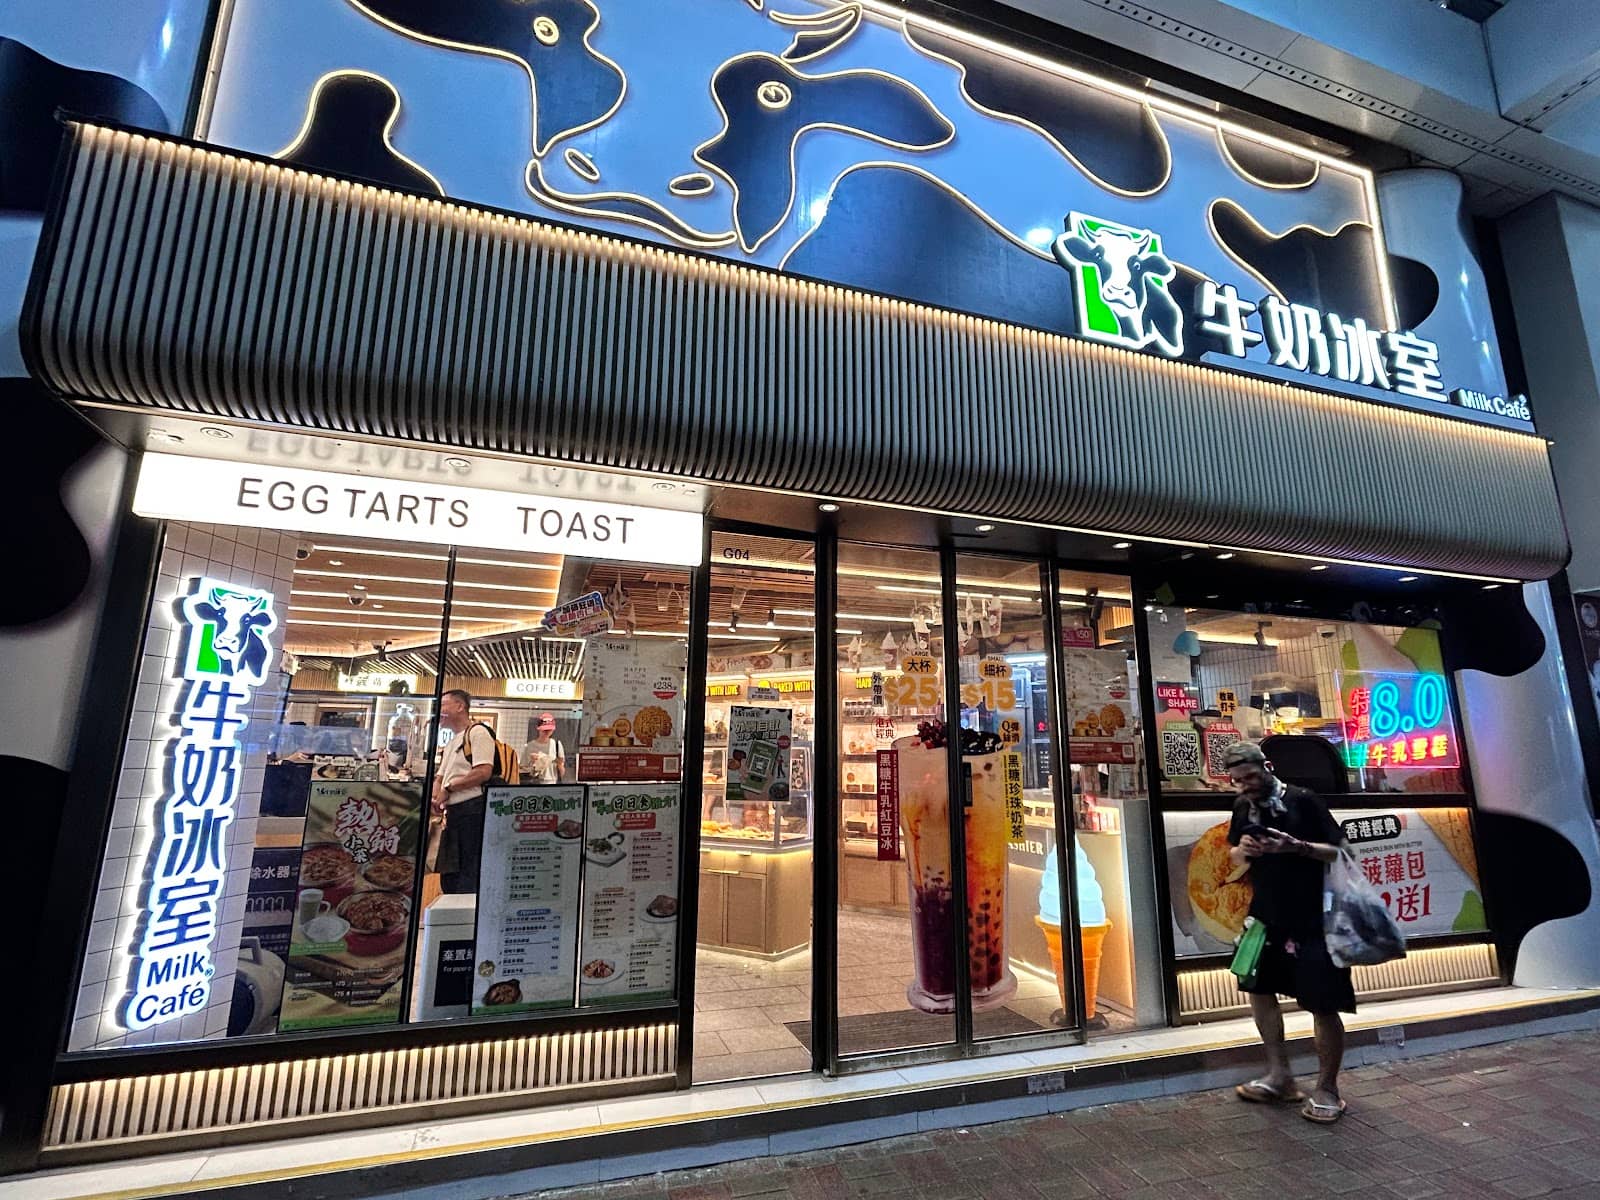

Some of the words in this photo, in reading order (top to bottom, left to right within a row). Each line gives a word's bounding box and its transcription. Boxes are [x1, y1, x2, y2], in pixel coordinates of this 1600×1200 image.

[1199, 284, 1447, 403] 牛奶冰室
[1459, 388, 1495, 413] Milk
[1493, 394, 1531, 421] Café
[237, 477, 330, 515] EGG
[343, 489, 470, 528] TARTS
[516, 506, 635, 544] TOAST
[723, 547, 750, 560] G04
[908, 660, 932, 673] 大杯
[984, 664, 1007, 677] 細杯
[516, 682, 566, 694] COFFEE
[885, 676, 939, 707] $25
[963, 681, 1017, 711] $15
[1158, 687, 1177, 698] LIKE
[1168, 699, 1198, 709] SHARE
[1371, 673, 1444, 738] 8.0
[880, 753, 893, 851] 黑糖牛乳紅豆冰
[1008, 754, 1023, 840] 黑糖珍珠奶茶
[147, 680, 250, 953] 牛奶冰室
[1345, 816, 1398, 840] 香港經典
[1361, 851, 1426, 886] 菠蘿包
[146, 951, 205, 988] Milk
[136, 981, 205, 1023] Café
